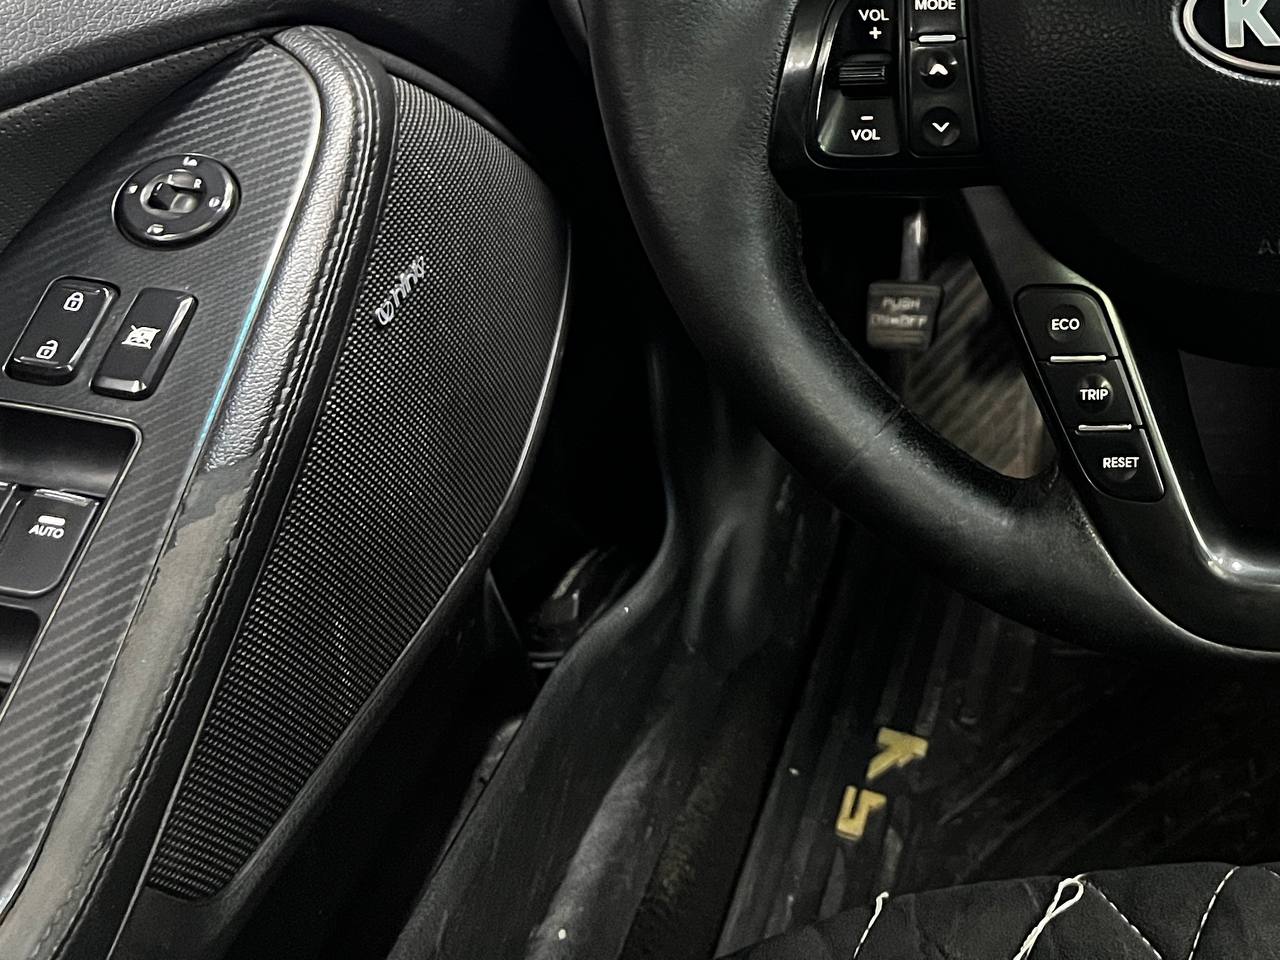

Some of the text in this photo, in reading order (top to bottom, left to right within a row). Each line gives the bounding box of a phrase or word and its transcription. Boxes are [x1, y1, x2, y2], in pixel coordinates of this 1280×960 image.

[858, 9, 890, 21] VOL
[850, 129, 881, 141] VOL
[193, 178, 202, 189] R
[1051, 318, 1080, 331] ECO
[1080, 389, 1109, 401] TRIP
[1103, 456, 1140, 469] RESET
[28, 522, 66, 539] AUTO
